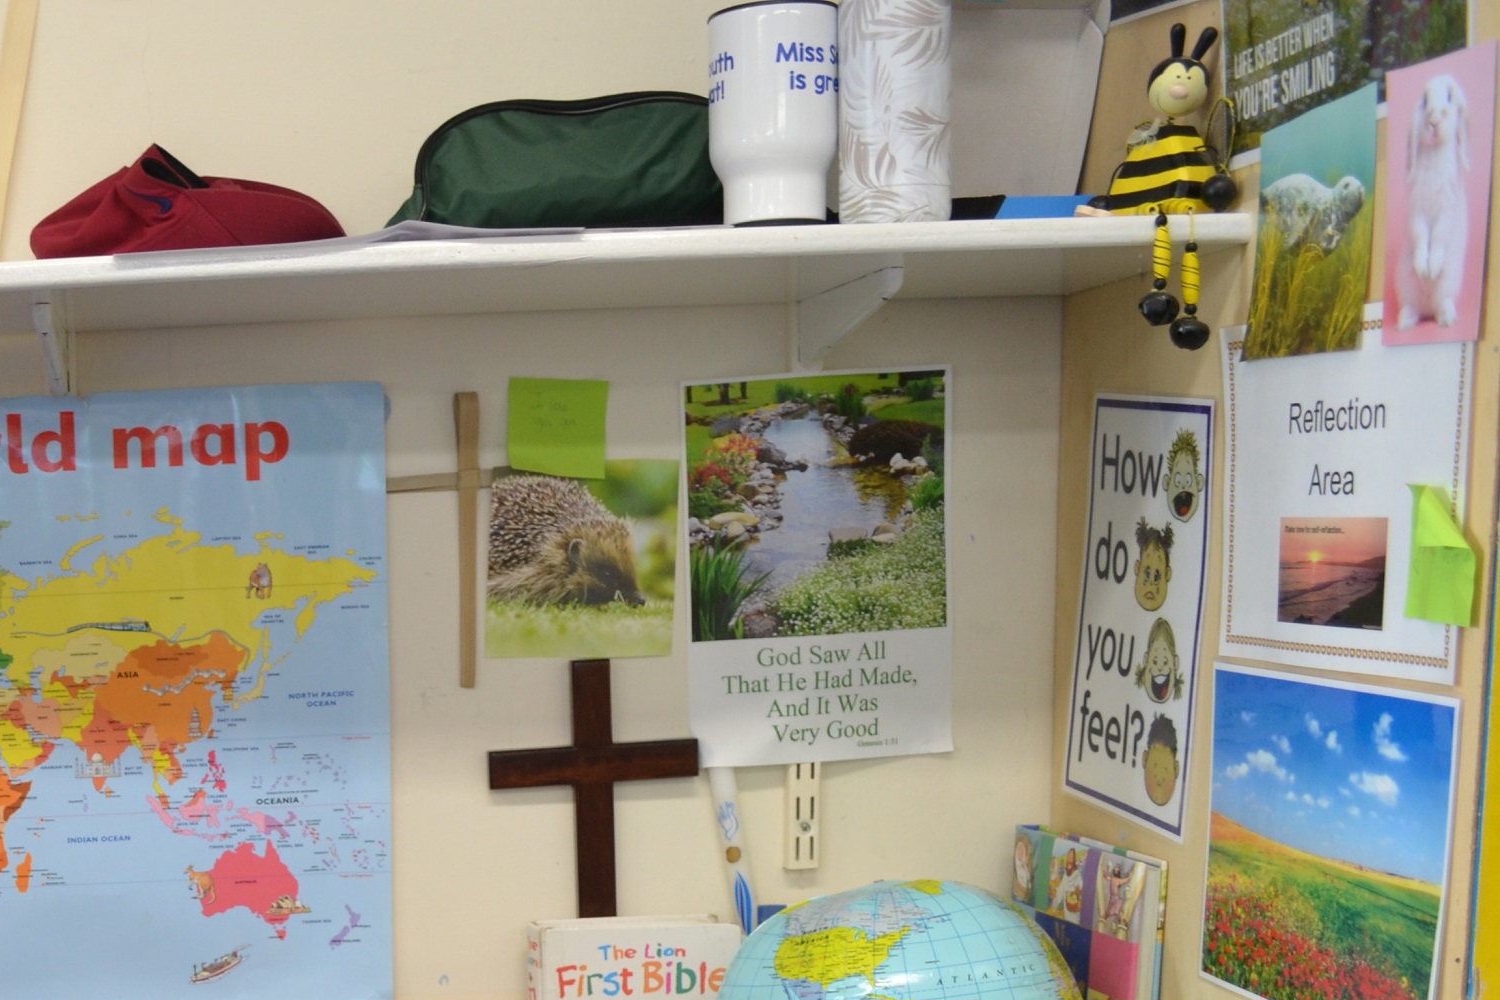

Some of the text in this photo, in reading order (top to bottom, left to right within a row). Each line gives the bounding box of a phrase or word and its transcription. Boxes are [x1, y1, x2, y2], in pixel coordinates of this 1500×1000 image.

[775, 42, 825, 64] Miss
[1234, 11, 1335, 80] LIFE IS BETTER WHEN
[789, 71, 839, 95] is gre
[1234, 50, 1336, 122] YOU'RE SMILING
[1288, 400, 1387, 435] Reflection
[112, 421, 291, 482] map
[1099, 432, 1164, 499] How
[1308, 464, 1355, 497] Area
[1094, 521, 1129, 586] do
[756, 640, 886, 668] God Saw All
[1086, 622, 1136, 681] you
[117, 671, 140, 679] ASIA
[721, 665, 918, 695] That He Had Made,
[288, 690, 355, 700] NORTH PACIFIC
[306, 699, 337, 708] OCEAN
[766, 695, 879, 719] And It Was
[773, 718, 880, 746] Very Good
[1077, 689, 1146, 770] feel?
[256, 796, 300, 806] OCEANIA
[67, 834, 131, 844] INDIAN OCEAN
[598, 942, 687, 962] The Lion
[556, 961, 727, 999] First Bible
[937, 964, 1036, 986] ATLANTIC
